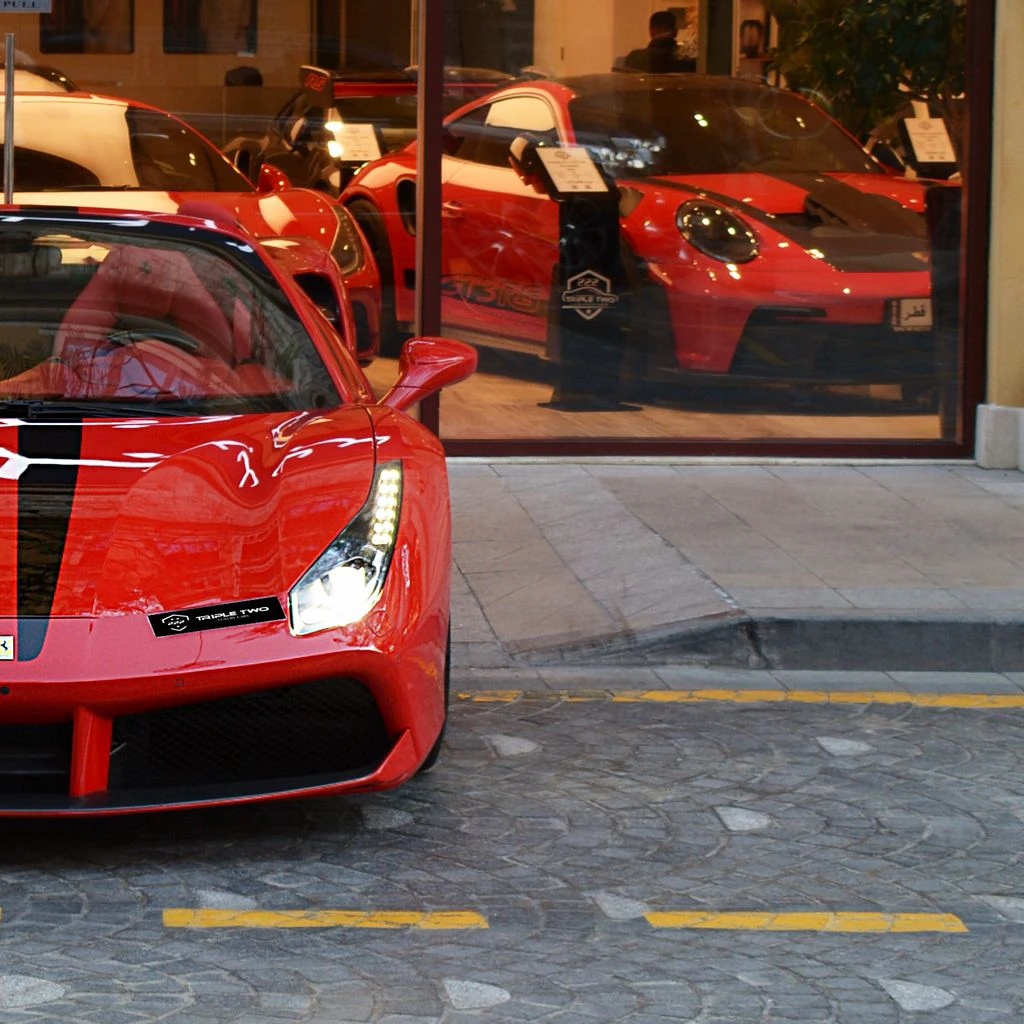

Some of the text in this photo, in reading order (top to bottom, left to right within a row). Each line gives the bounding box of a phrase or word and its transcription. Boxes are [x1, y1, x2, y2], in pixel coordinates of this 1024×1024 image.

[1, 0, 40, 9] PULL
[577, 278, 600, 287] 222
[195, 606, 270, 622] TRIPLE TWO
